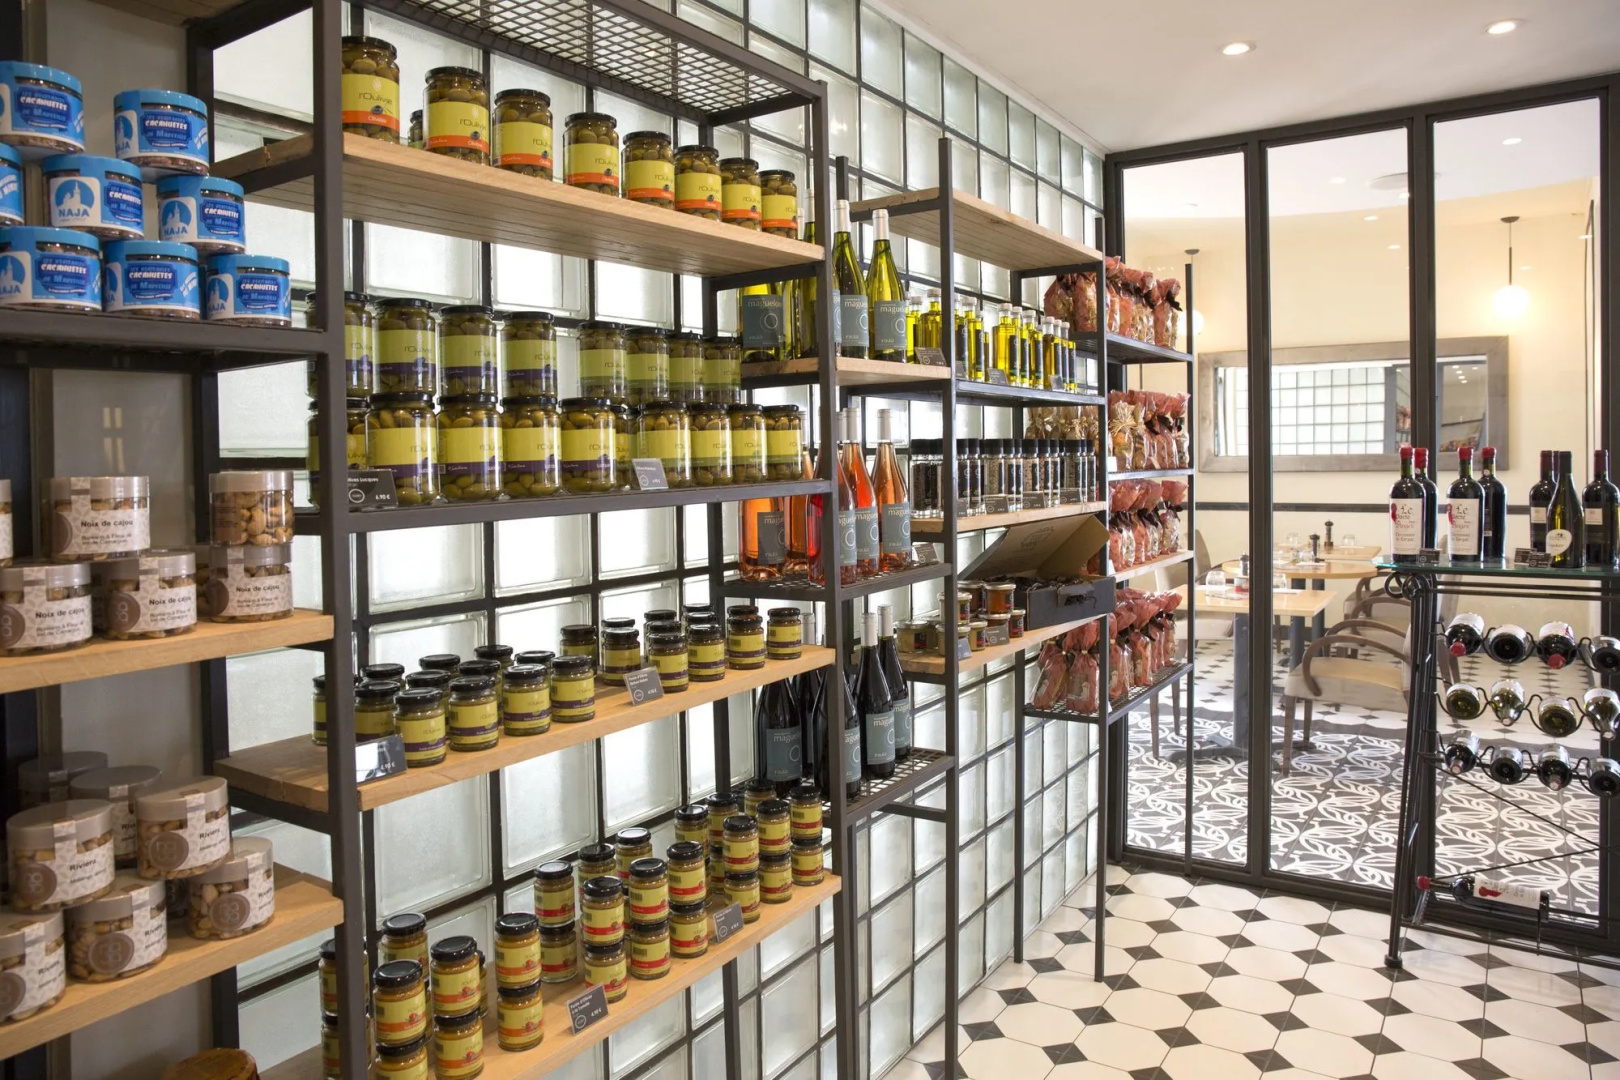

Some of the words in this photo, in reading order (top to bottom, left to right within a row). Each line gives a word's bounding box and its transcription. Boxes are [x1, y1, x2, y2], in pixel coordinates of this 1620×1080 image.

[58, 208, 90, 218] NAJA
[164, 226, 188, 236] NAJA
[36, 611, 55, 619] Noix
[199, 828, 220, 840] Riviera
[70, 859, 96, 871] Riviera
